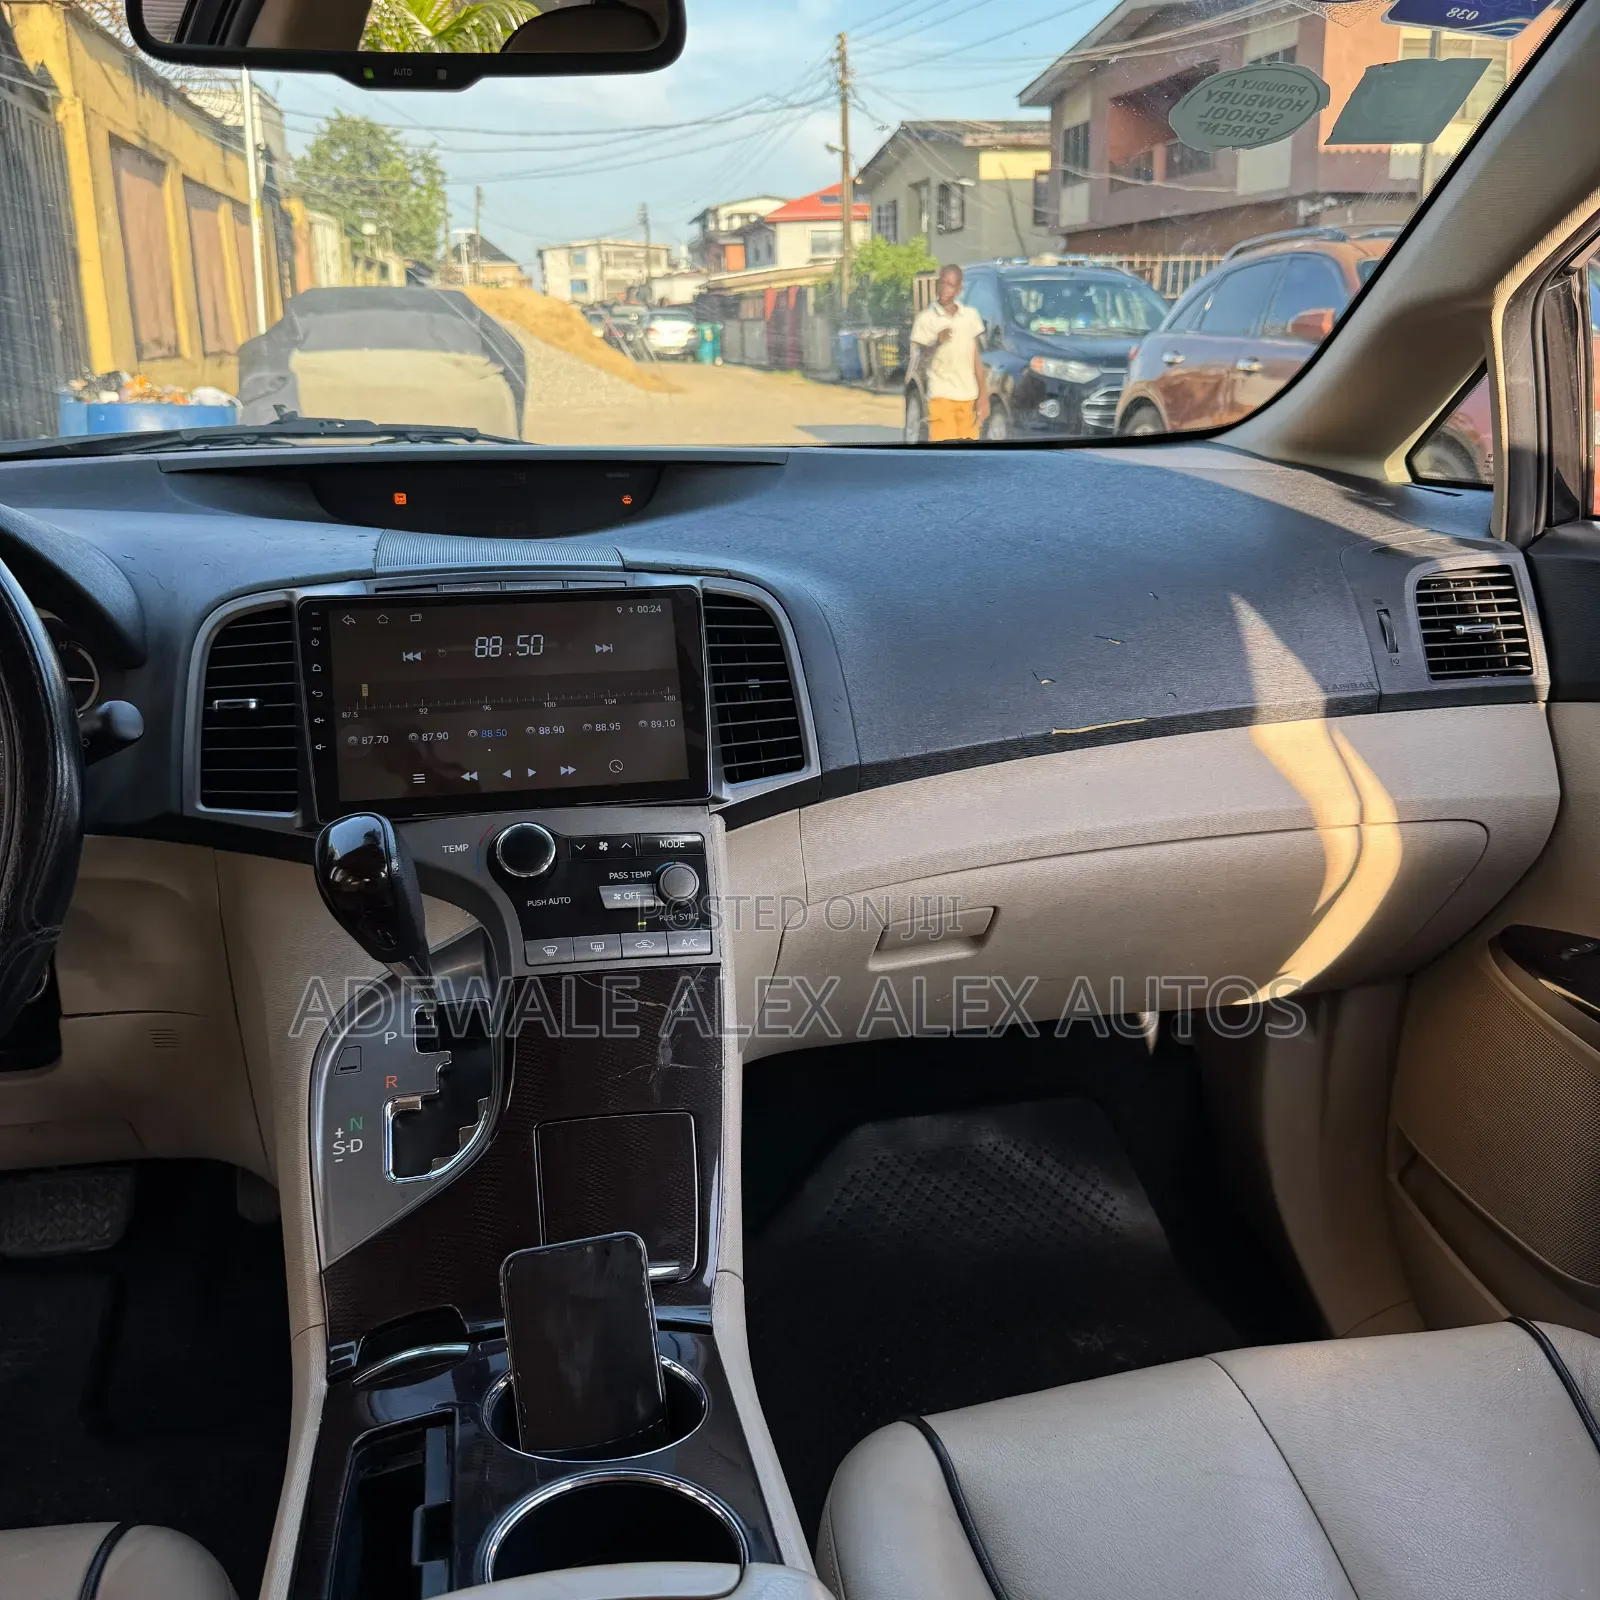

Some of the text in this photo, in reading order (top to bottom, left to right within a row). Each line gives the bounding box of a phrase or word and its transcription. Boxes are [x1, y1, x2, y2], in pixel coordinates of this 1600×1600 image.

[393, 68, 413, 77] AUTO
[637, 604, 662, 614] 00:24
[475, 635, 544, 658] 88.50
[543, 701, 557, 709] 100
[604, 698, 617, 706] 104
[418, 707, 429, 716] 92
[482, 704, 492, 712] 96
[595, 722, 621, 732] 88.95
[650, 719, 676, 729] 89.10
[481, 728, 508, 738] 88.50
[538, 725, 565, 735] 88.90
[361, 735, 389, 745] 87.70
[421, 731, 449, 742] 87.90
[442, 843, 470, 853] TEMP
[659, 839, 686, 849] MODE
[609, 870, 652, 880] PASS TEMP
[623, 891, 641, 900] OFF
[548, 896, 572, 906] AUTO
[659, 912, 700, 922] PUSH SYNC
[681, 937, 699, 947] A/C
[384, 1031, 398, 1045] P
[385, 1075, 398, 1089] R
[349, 1116, 363, 1131] N
